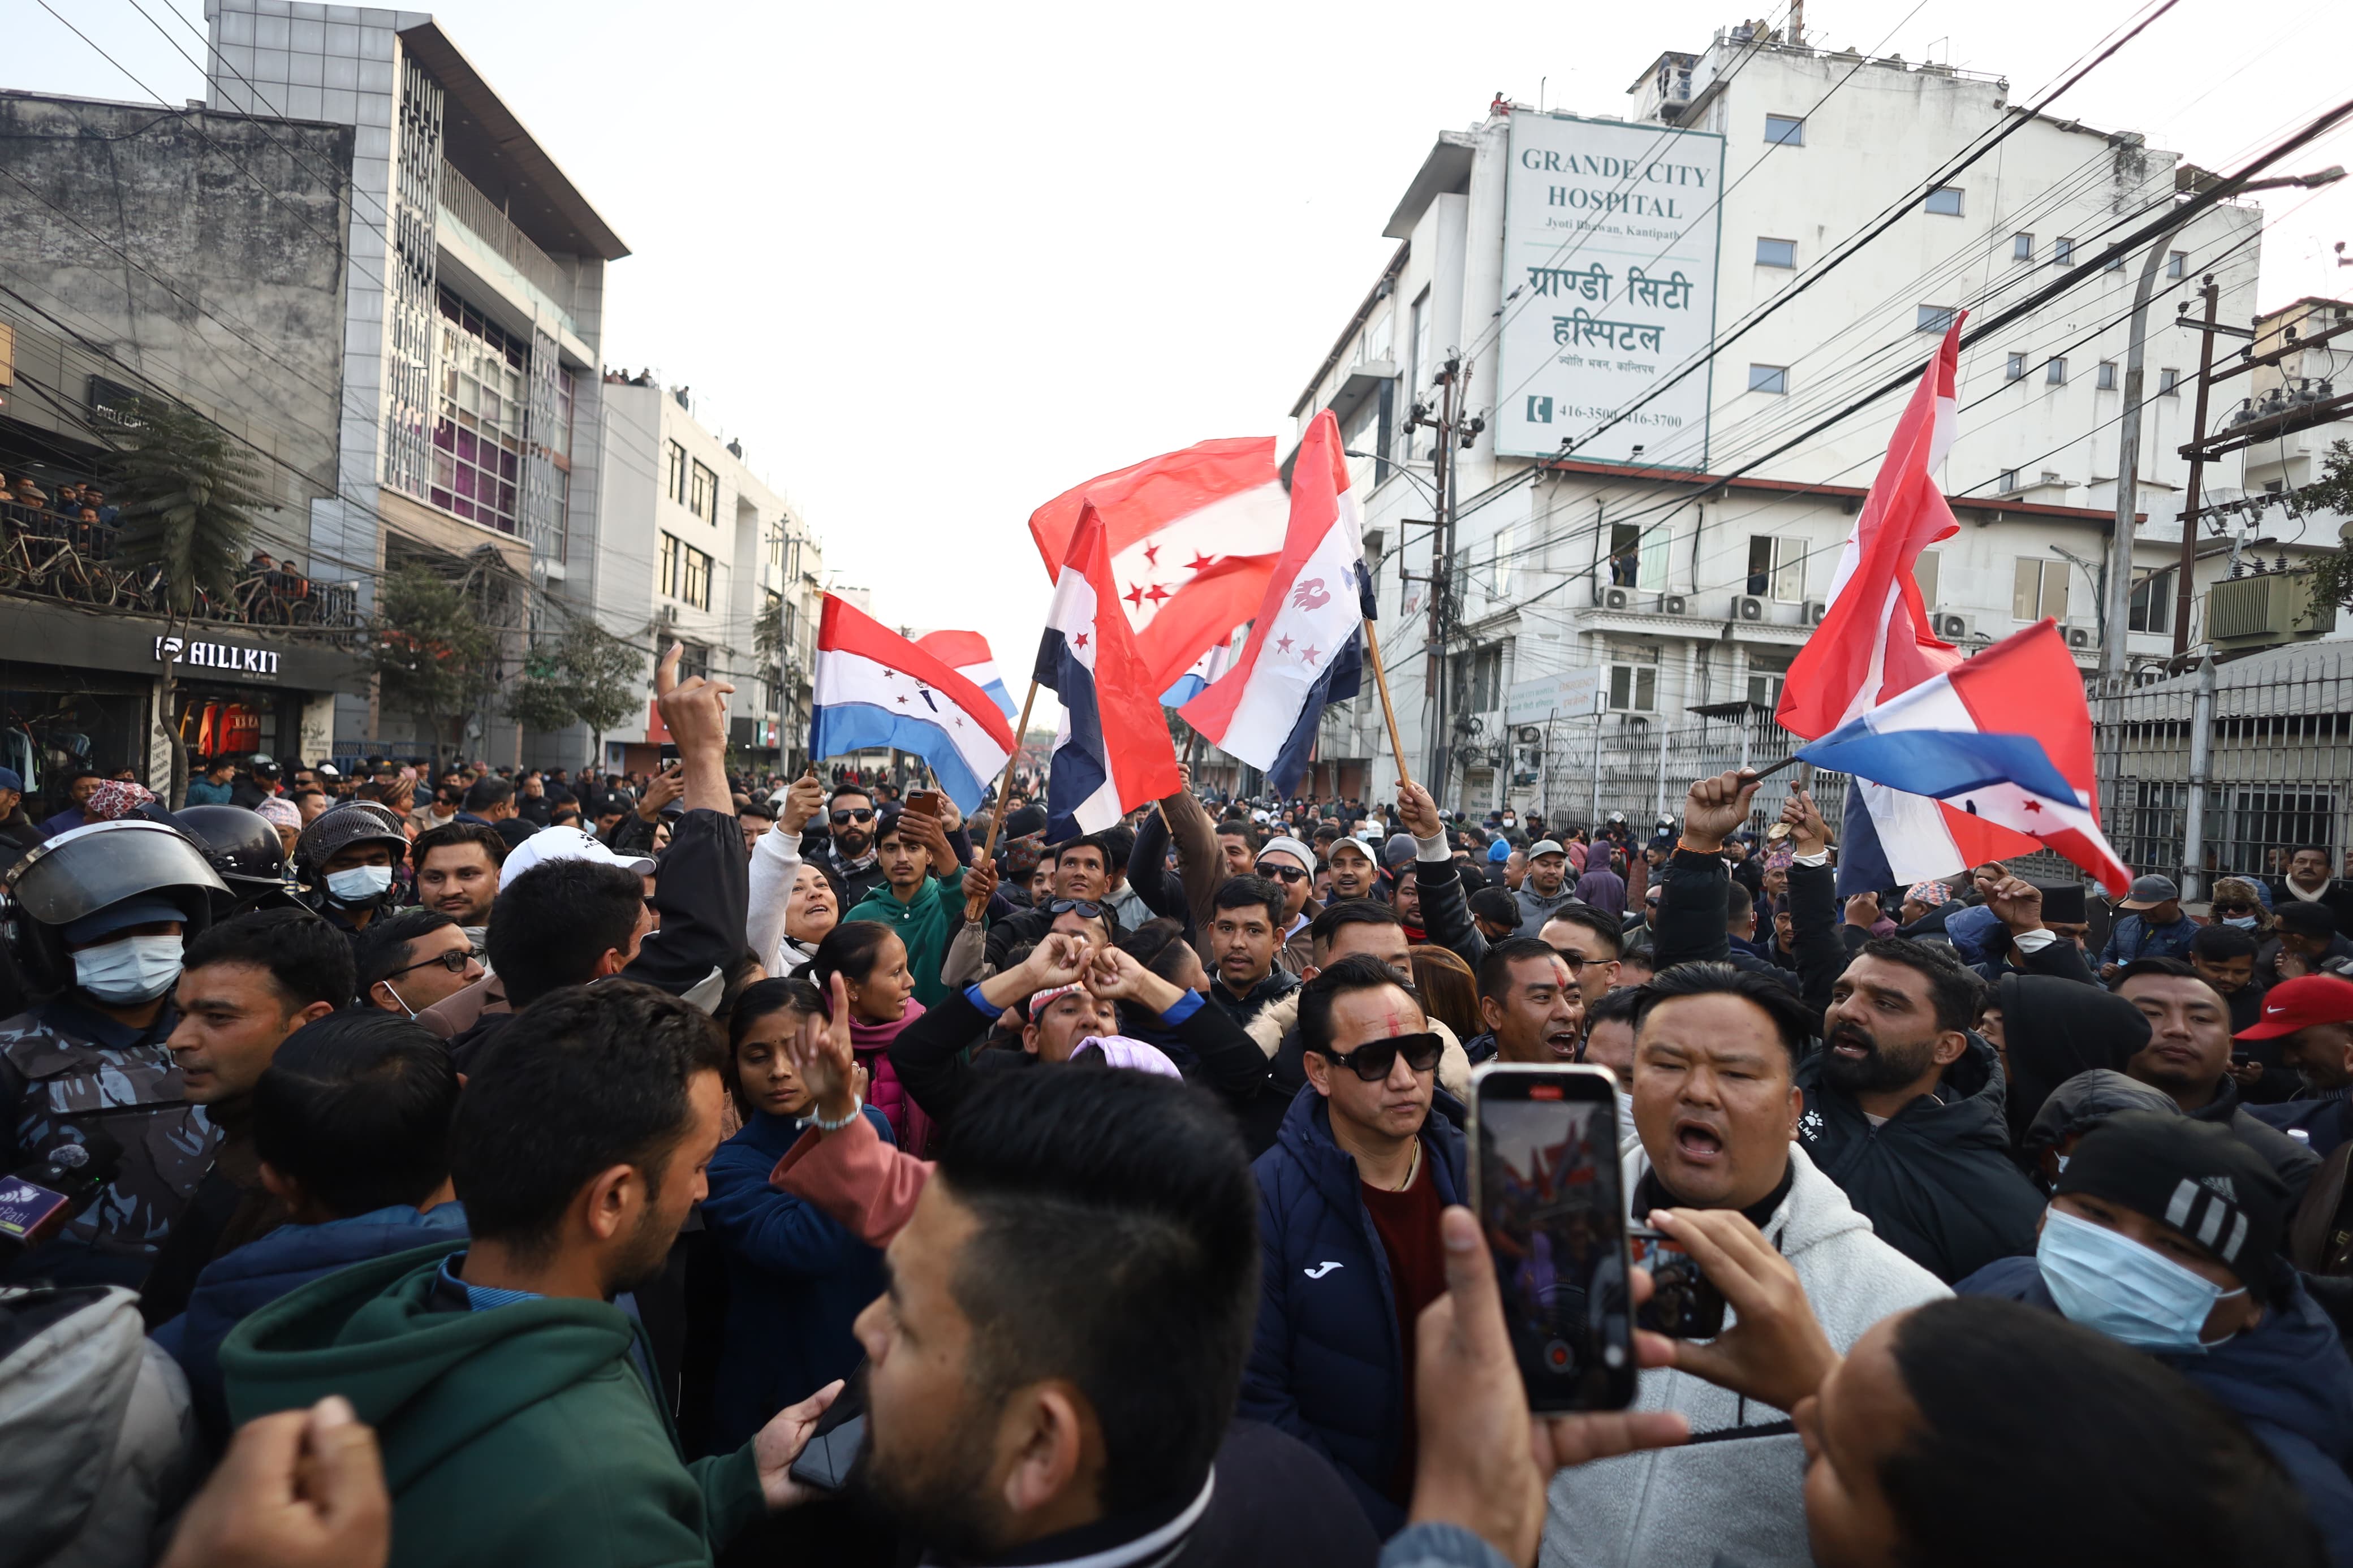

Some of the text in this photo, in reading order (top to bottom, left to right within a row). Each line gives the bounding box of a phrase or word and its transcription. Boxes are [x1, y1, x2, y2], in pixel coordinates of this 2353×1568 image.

[1522, 148, 1711, 188] GRANDE CITY
[1548, 185, 1683, 219] HOSPITAL
[1545, 217, 1574, 231] Jyoti
[1626, 224, 1681, 241] Kantipath
[1527, 262, 1693, 311] ग्राण्डी सिटी
[1552, 306, 1665, 355] हस्पिटल
[189, 641, 281, 673] HILLKIT
[1798, 1117, 1818, 1142] LME
